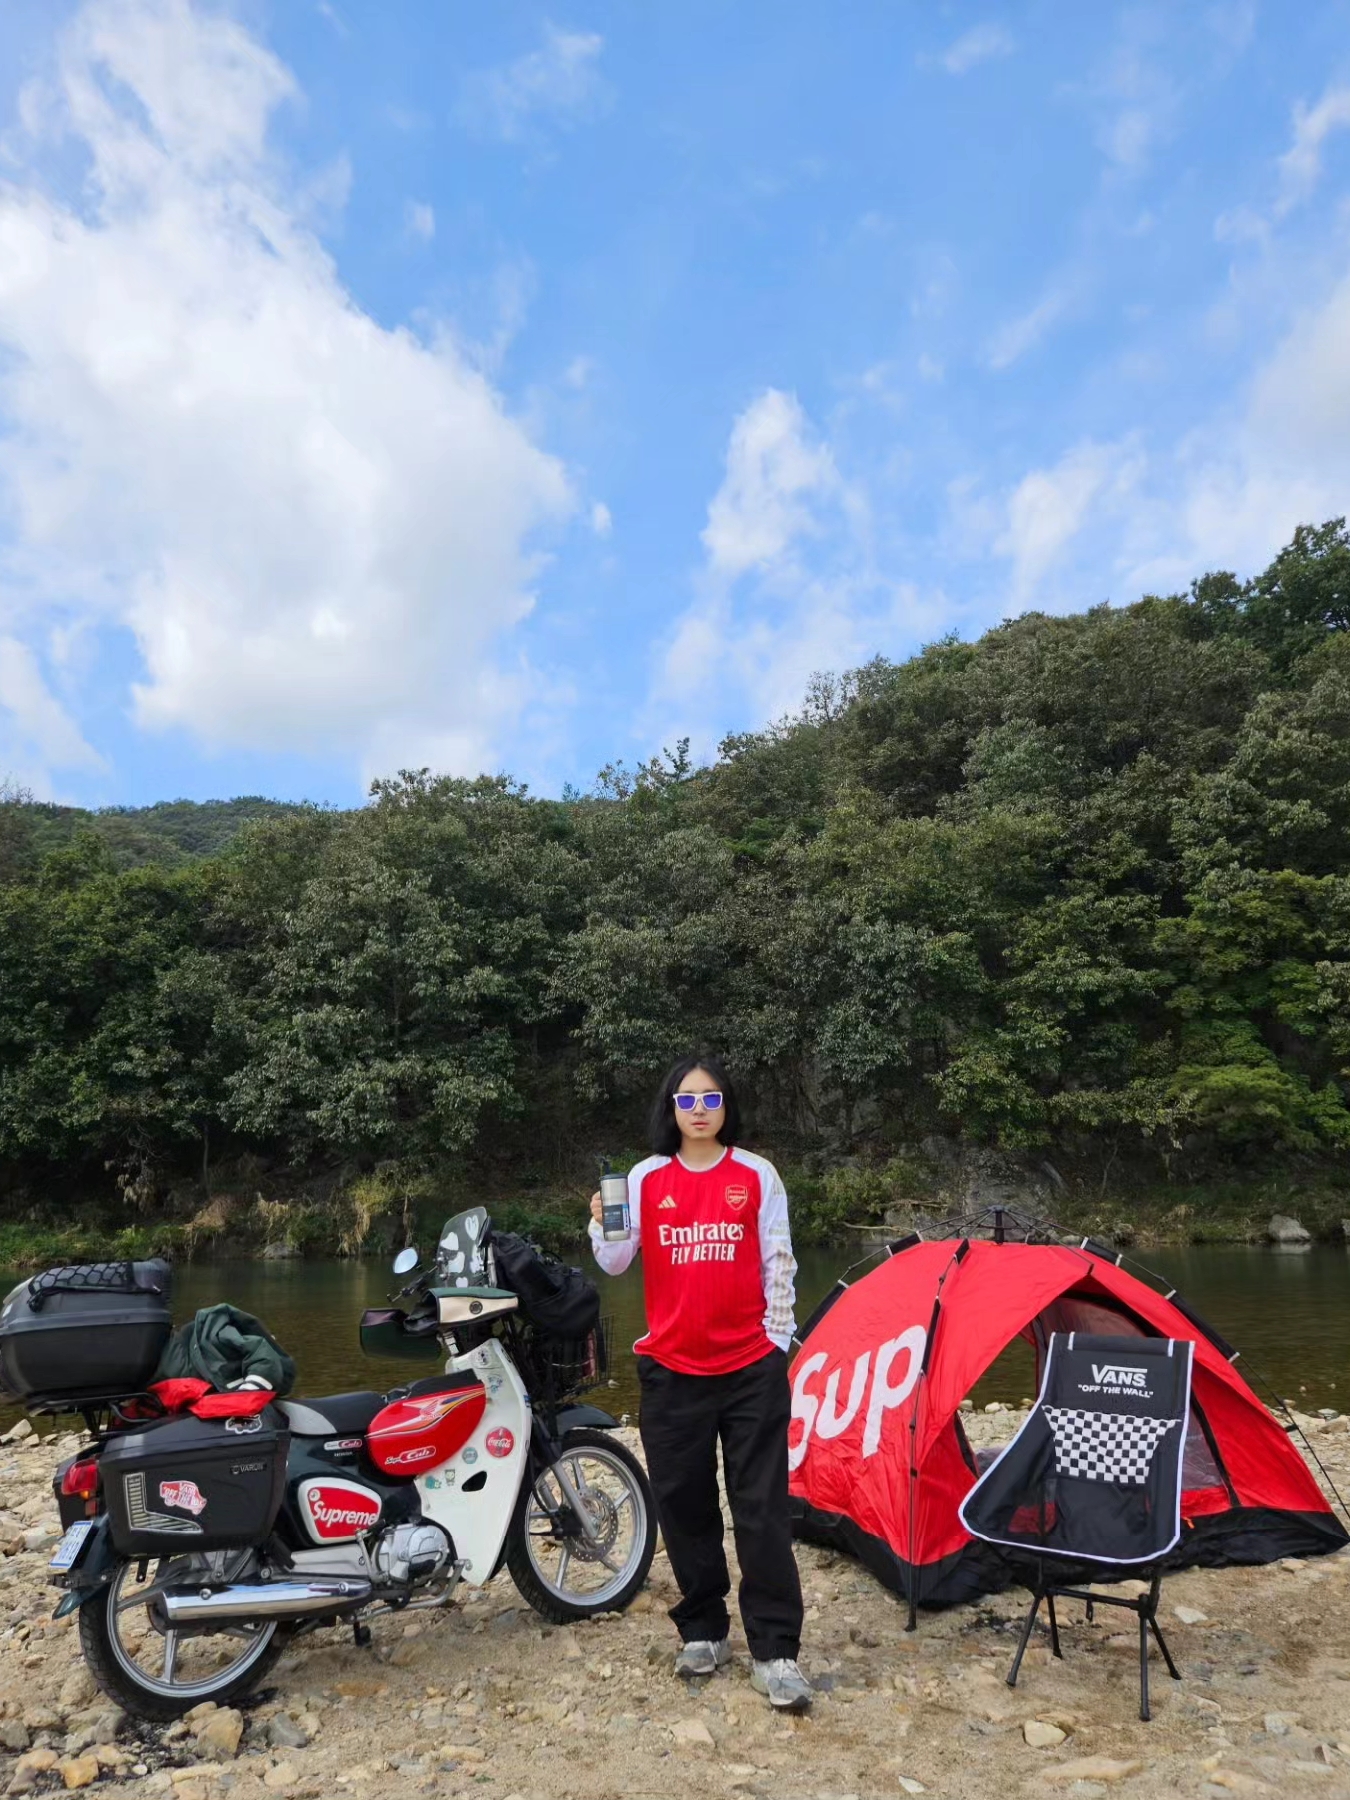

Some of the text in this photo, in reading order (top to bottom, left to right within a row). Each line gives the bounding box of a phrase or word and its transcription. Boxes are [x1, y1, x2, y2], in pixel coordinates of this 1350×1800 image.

[658, 1220, 744, 1246] Emirates
[671, 1243, 736, 1265] FLY BETTER
[1091, 1363, 1148, 1388] VANS
[1102, 1386, 1121, 1395] THE
[313, 1500, 379, 1528] Supreme
